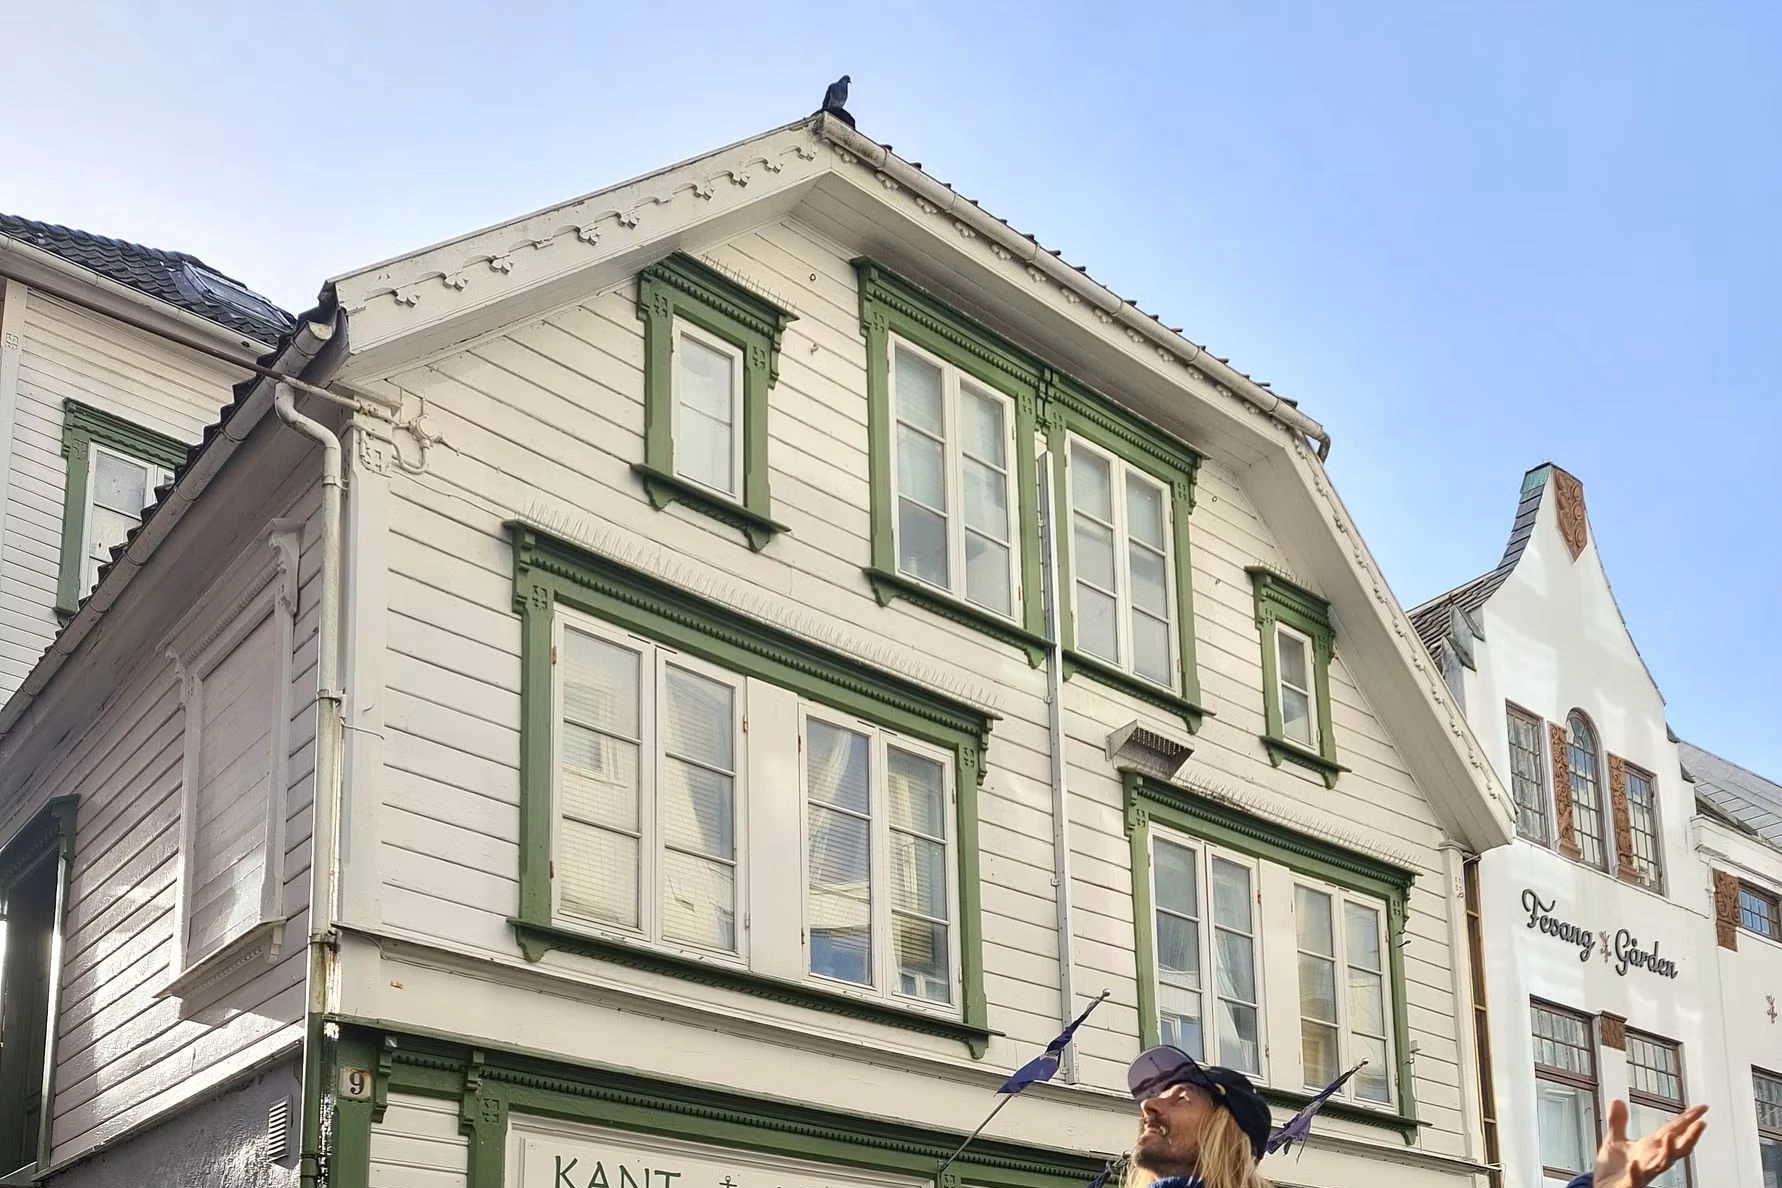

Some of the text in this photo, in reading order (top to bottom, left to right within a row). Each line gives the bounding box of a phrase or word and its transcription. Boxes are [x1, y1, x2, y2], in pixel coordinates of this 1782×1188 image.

[1521, 888, 1679, 980] Fevang Gården
[349, 1071, 365, 1095] 9
